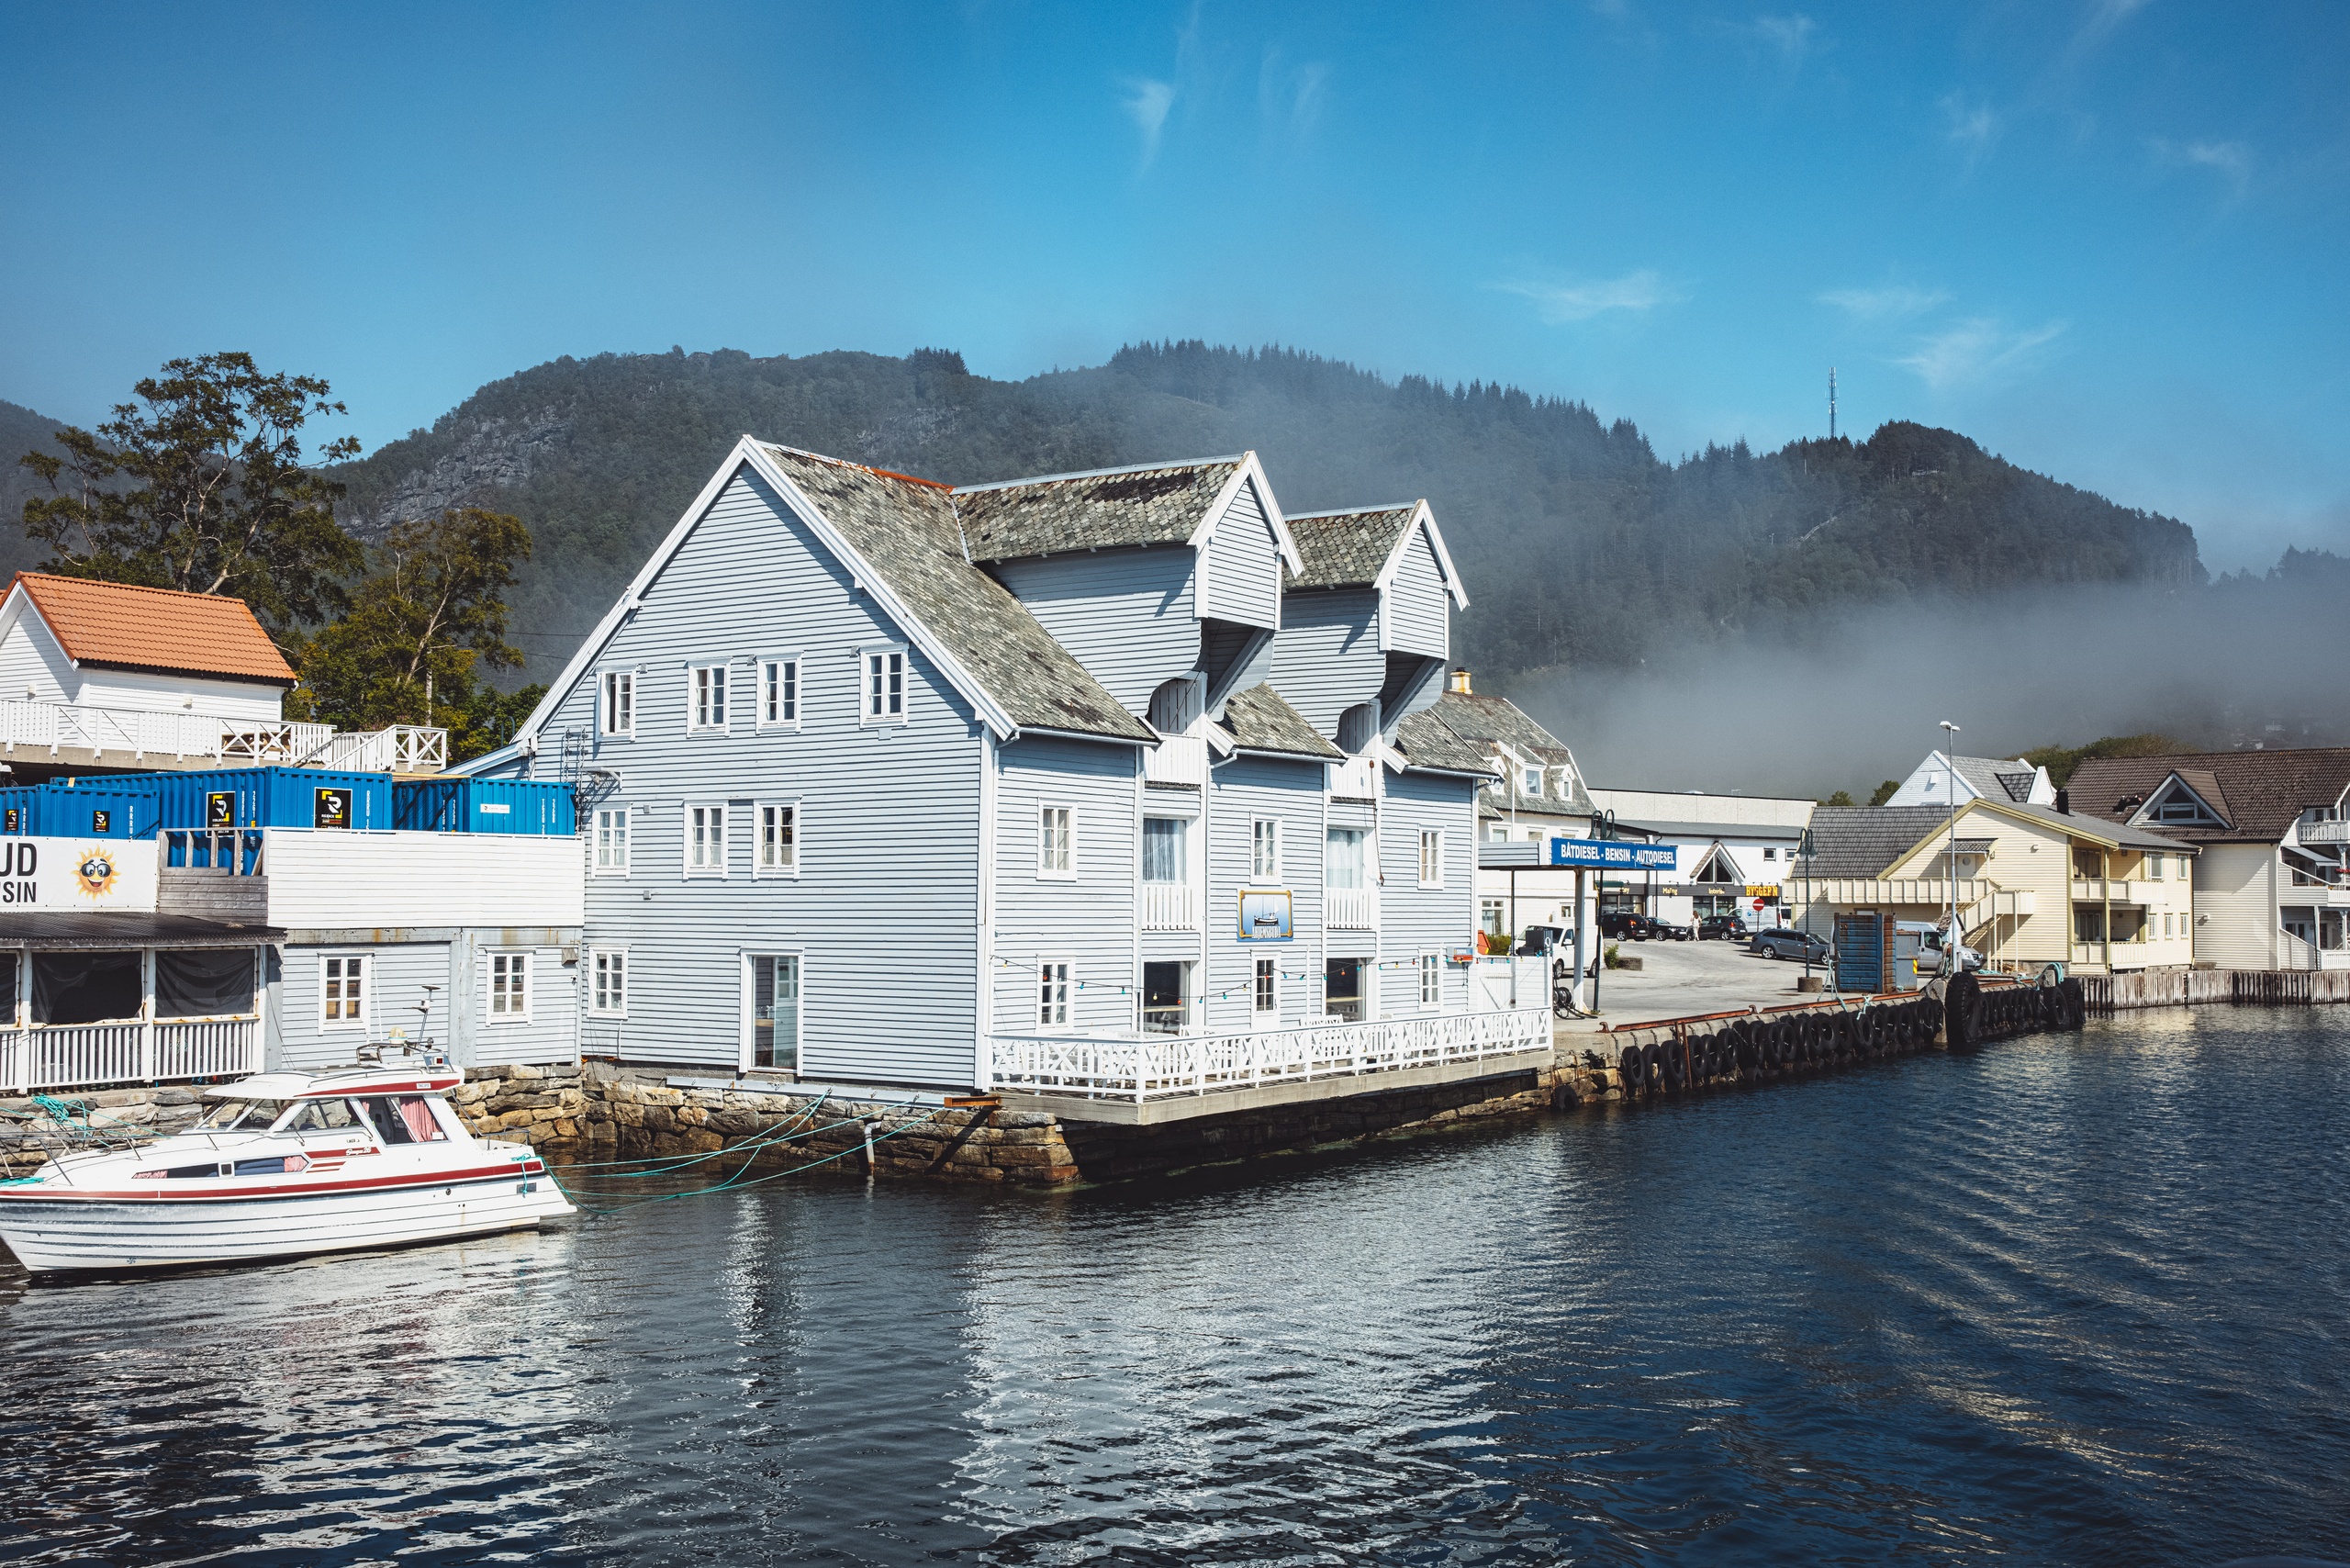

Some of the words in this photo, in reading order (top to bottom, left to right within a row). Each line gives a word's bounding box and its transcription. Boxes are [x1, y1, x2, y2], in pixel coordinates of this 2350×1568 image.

[1561, 841, 1600, 860] BÅTDIESEL
[1606, 847, 1631, 862] BENSIN
[1636, 849, 1675, 865] AUTODIESEL
[0, 881, 37, 902] SIN
